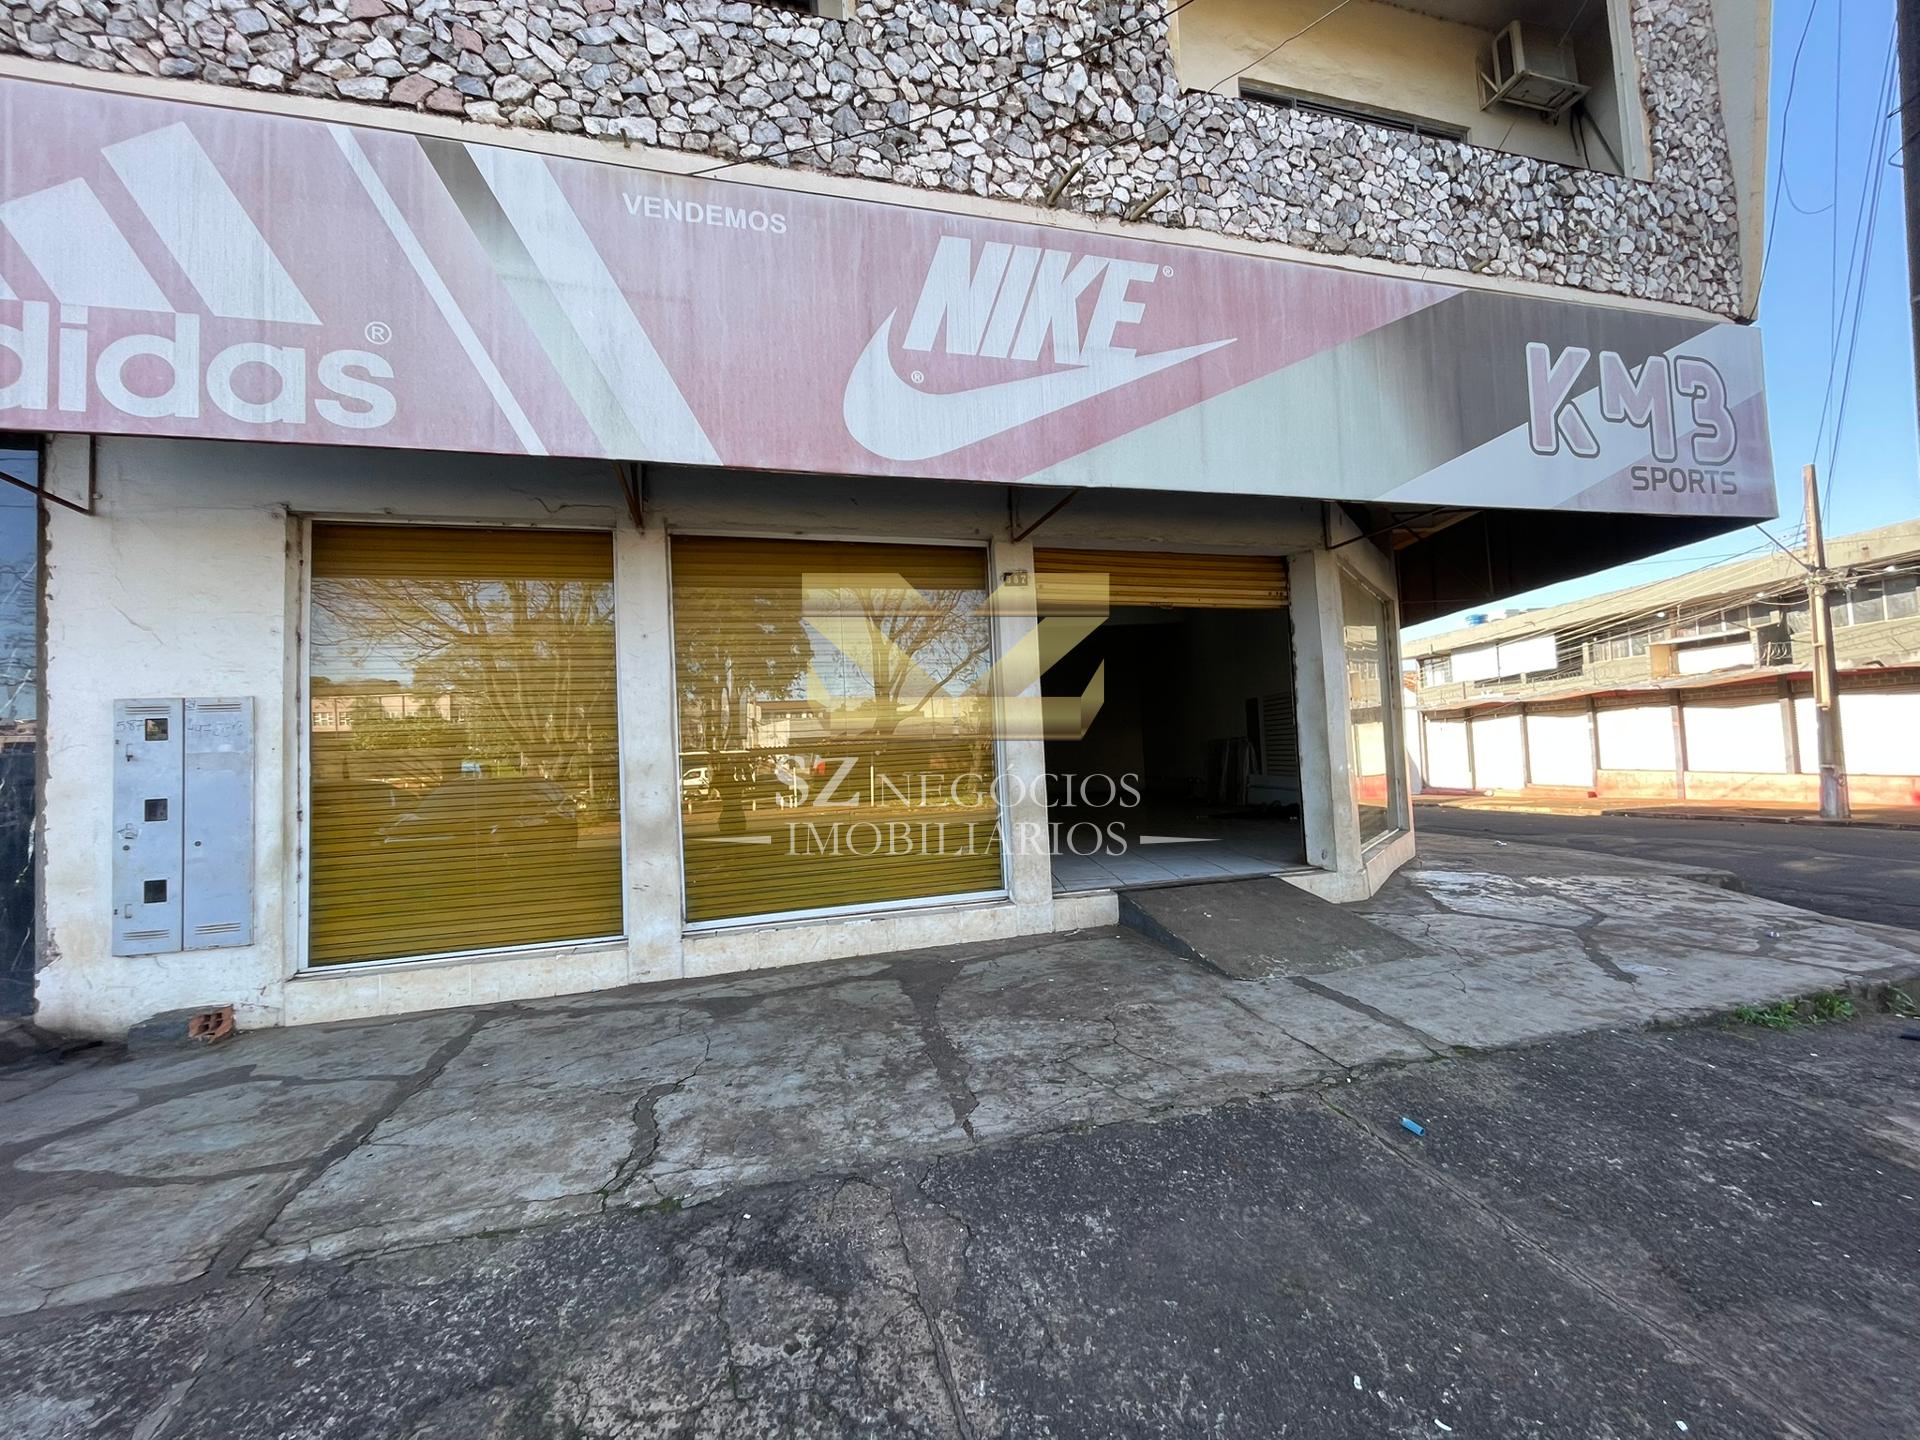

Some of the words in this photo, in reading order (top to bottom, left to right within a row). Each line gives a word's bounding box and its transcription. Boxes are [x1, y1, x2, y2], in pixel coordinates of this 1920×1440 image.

[622, 192, 787, 234] VENDEMOS
[902, 235, 1159, 366] NIKE
[1525, 341, 1738, 466] KM3
[1630, 465, 1738, 495] SPORTS
